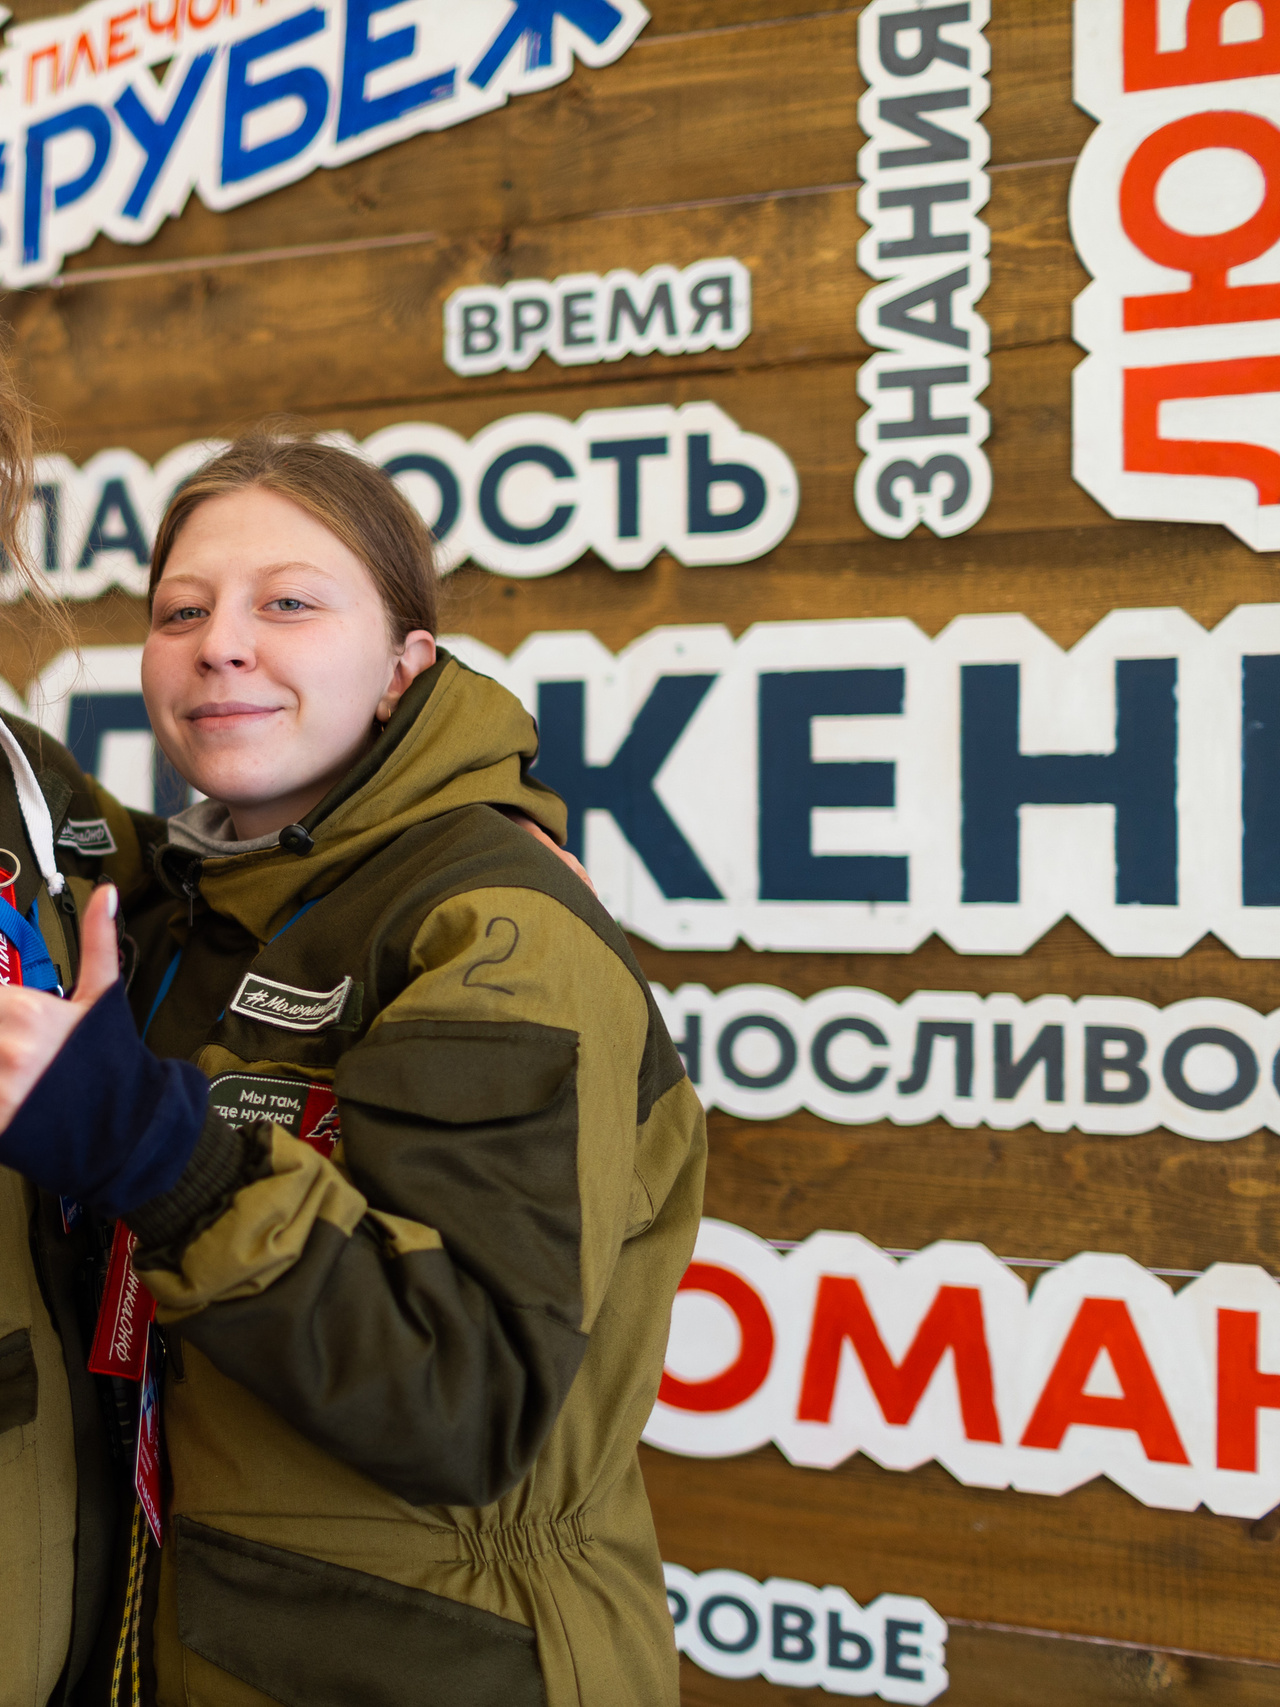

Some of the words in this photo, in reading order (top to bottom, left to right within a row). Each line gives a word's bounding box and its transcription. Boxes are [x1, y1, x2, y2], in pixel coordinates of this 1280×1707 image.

[875, 3, 971, 519] ЗНАНИЯ
[462, 275, 732, 356] ВРЕМЯ
[462, 916, 519, 996] 2
[239, 1089, 266, 1106] Мы
[269, 1094, 302, 1112] там,
[677, 1015, 1280, 1111] ОСЛИВО
[240, 1108, 295, 1125] нужна
